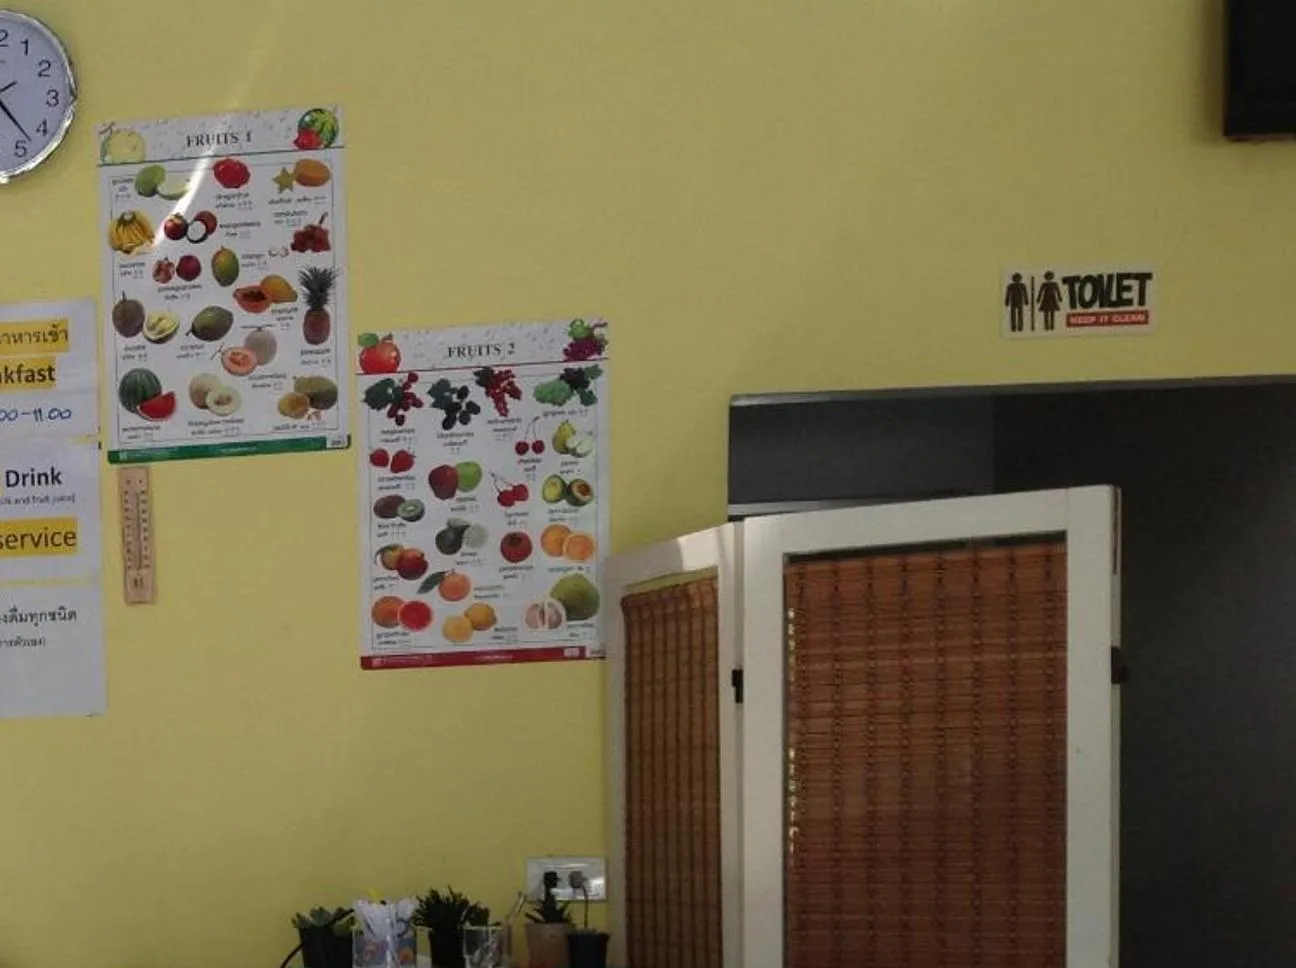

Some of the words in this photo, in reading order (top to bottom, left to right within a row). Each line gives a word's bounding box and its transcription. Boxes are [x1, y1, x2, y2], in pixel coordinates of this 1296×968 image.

[20, 39, 29, 56] 1
[38, 60, 51, 78] 2
[46, 90, 59, 107] 3
[36, 120, 48, 136] 4
[186, 131, 240, 148] FRUITS
[15, 140, 28, 157] 5
[447, 344, 502, 359] FRUITS
[507, 342, 516, 356] 2
[5, 466, 63, 488] Drink
